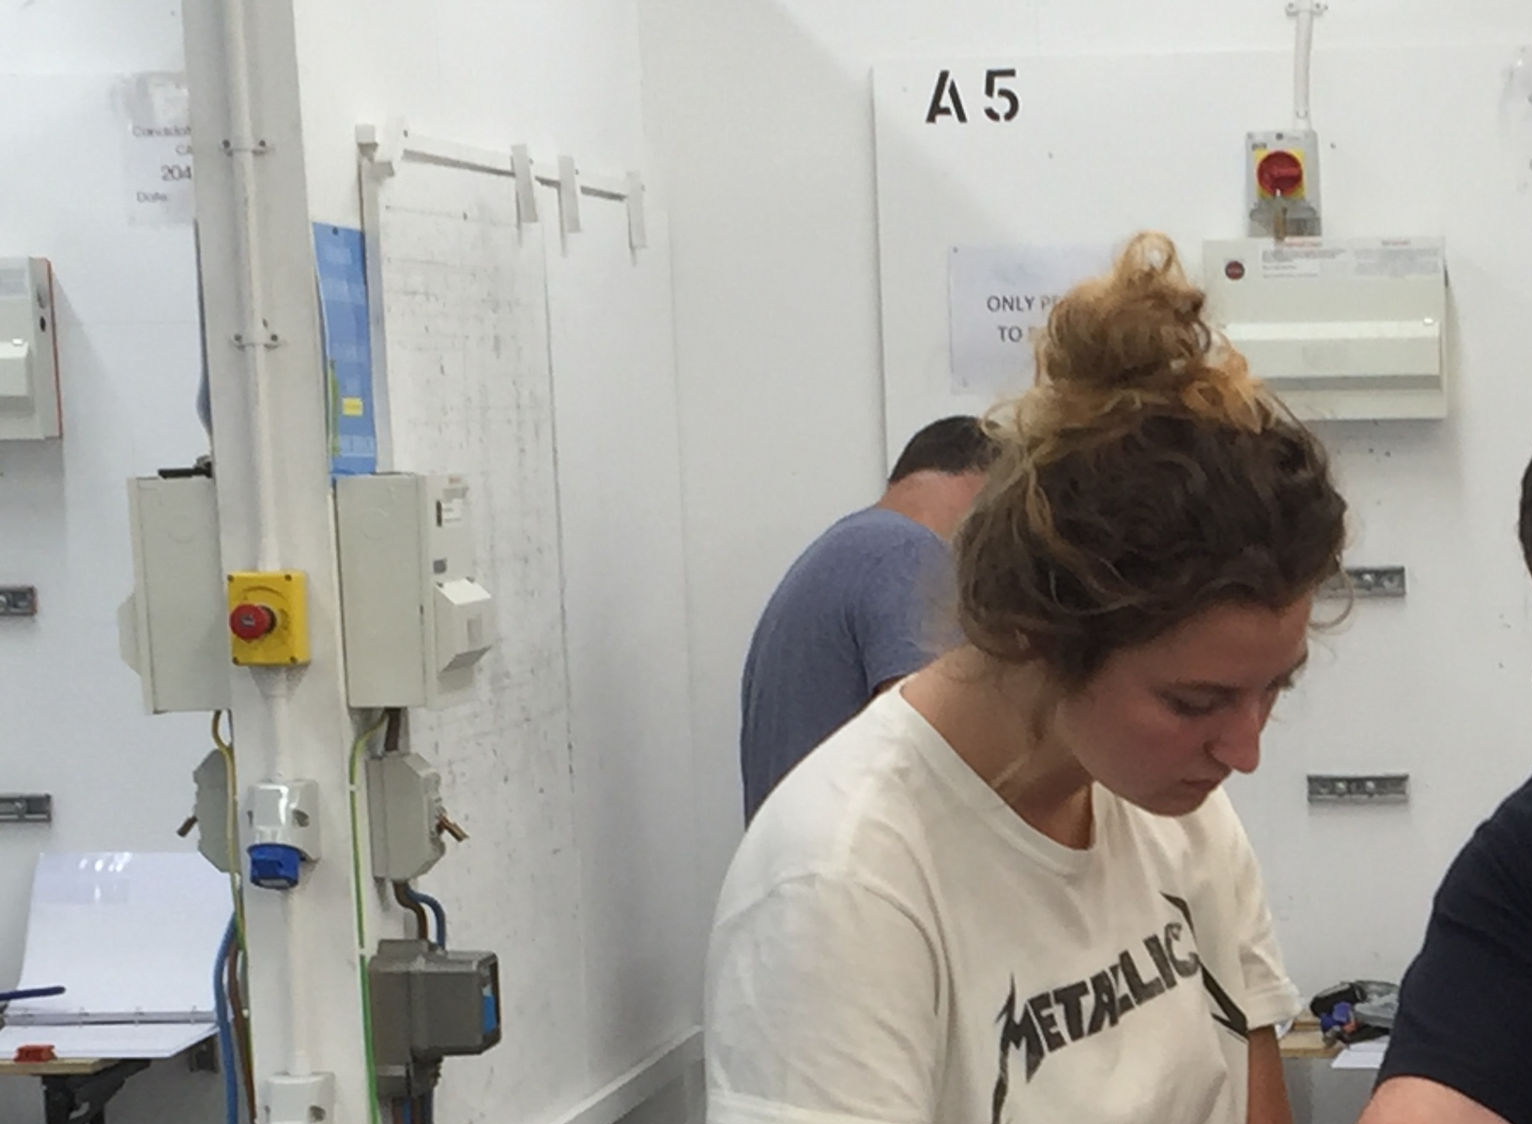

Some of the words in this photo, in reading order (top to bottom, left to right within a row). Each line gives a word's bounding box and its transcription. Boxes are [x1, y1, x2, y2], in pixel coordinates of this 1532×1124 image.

[161, 165, 192, 181] 204
[986, 295, 1035, 313] ONLY
[997, 325, 1023, 343] TO
